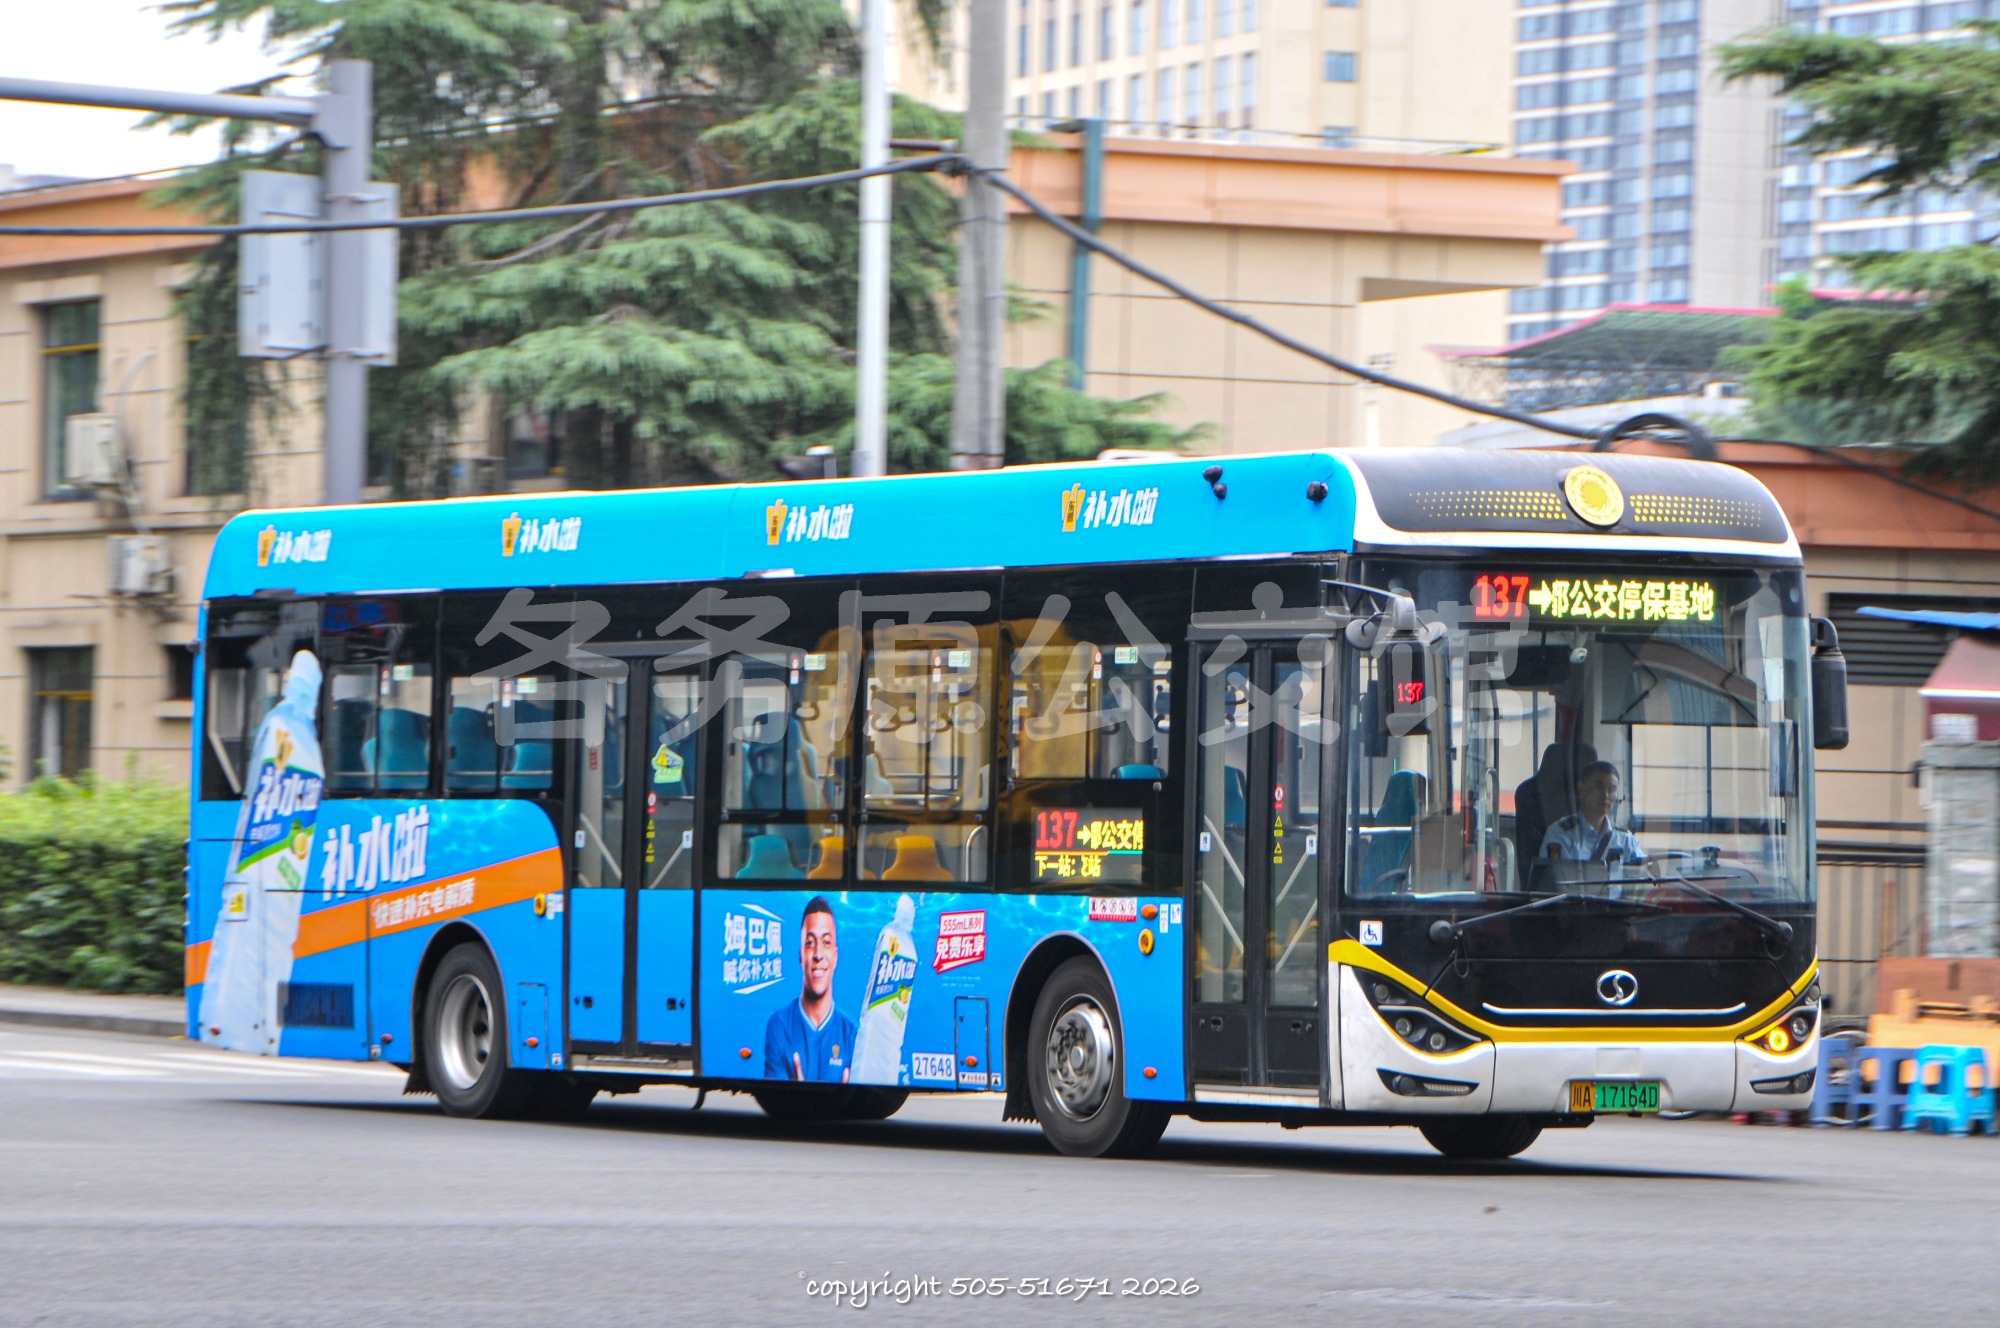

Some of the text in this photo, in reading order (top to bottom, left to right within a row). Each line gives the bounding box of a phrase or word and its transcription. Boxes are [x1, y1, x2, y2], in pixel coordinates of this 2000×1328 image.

[786, 503, 854, 543] 补水啦
[1083, 487, 1159, 529] 补水啦
[1474, 574, 1530, 618] 137
[1397, 681, 1425, 703] 137
[1035, 810, 1080, 849] 137
[320, 804, 430, 901] 补水啦
[723, 911, 783, 956] 姆巴佩
[942, 916, 983, 932] 555mL系列
[934, 934, 986, 967] 免费乐享
[878, 955, 917, 985] 补水啦
[914, 1056, 953, 1077] 27648
[1572, 1085, 1658, 1108] 川A 17164D
